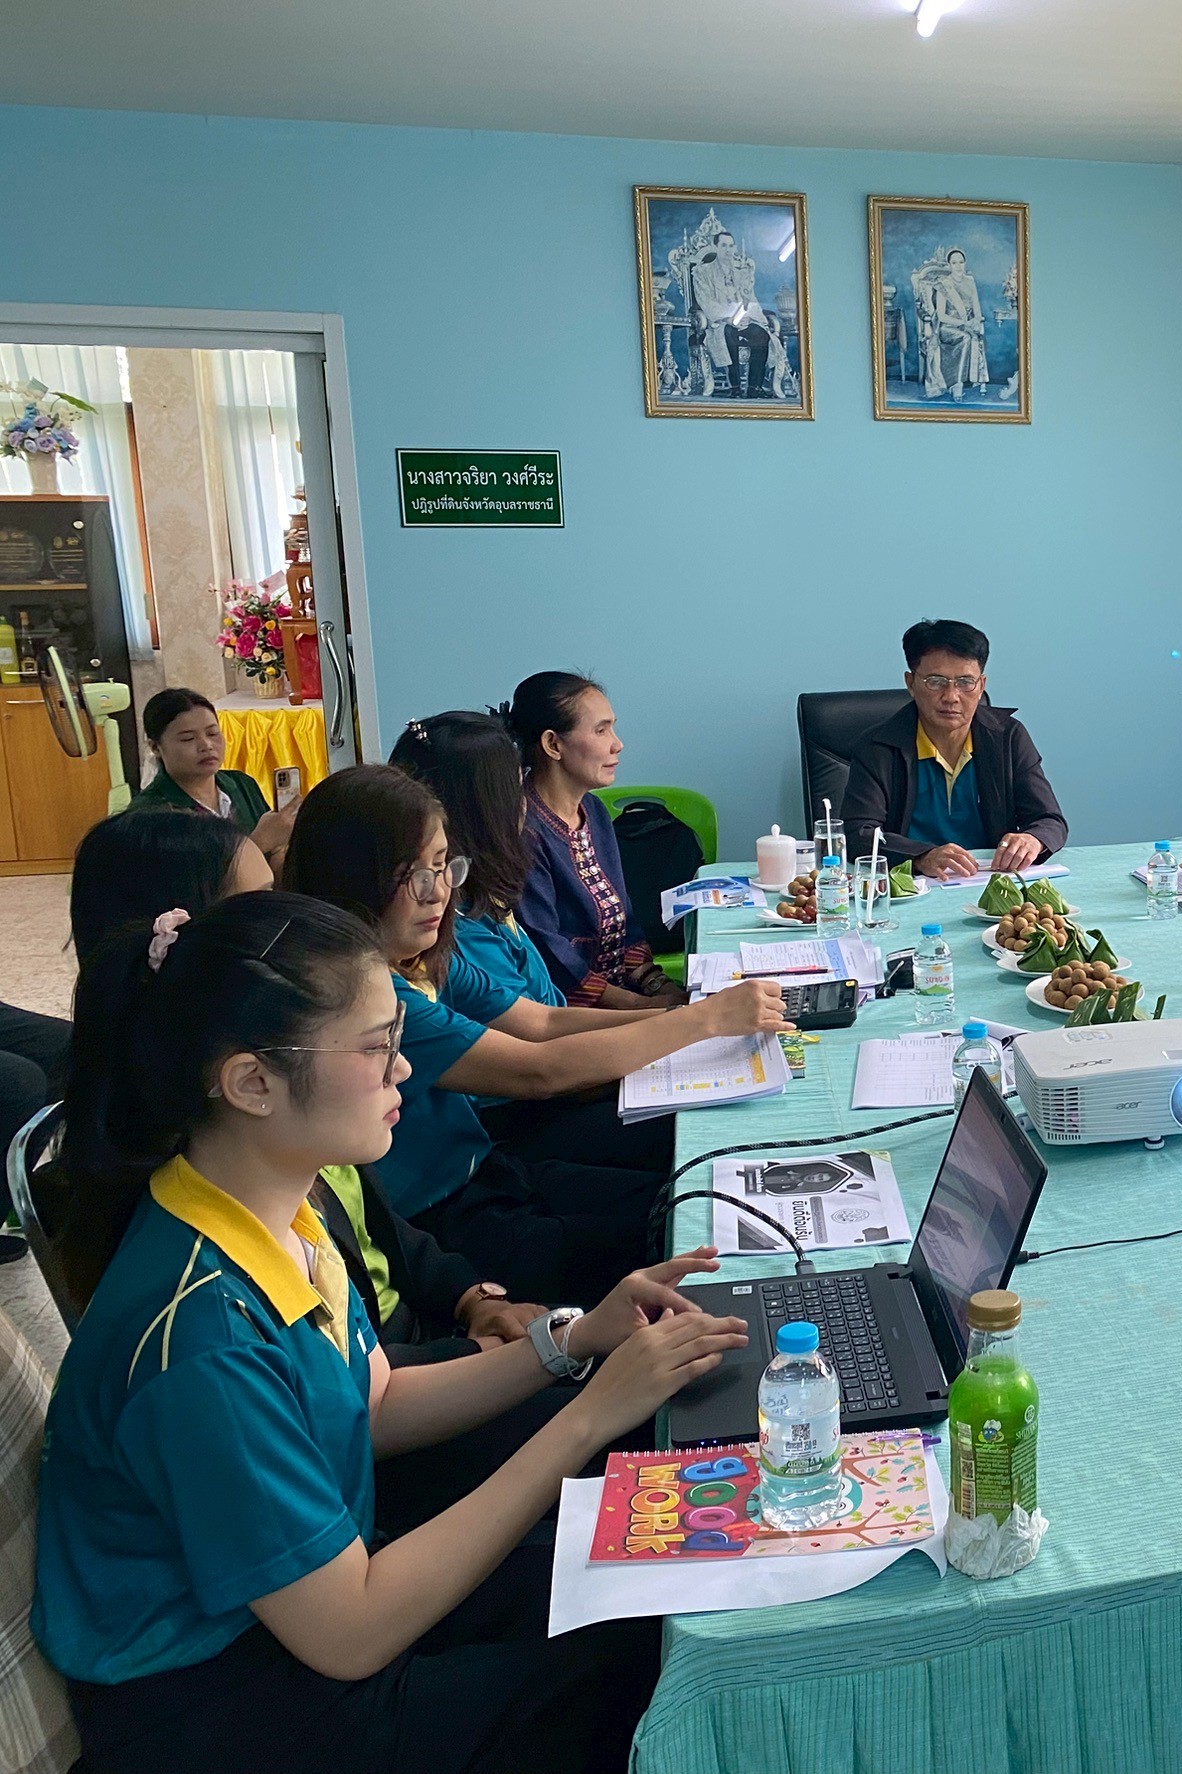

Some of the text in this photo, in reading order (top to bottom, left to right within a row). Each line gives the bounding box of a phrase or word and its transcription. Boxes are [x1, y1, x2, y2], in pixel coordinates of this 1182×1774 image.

[407, 463, 554, 486] นางสาวจริยา วงศ์วีระ
[1114, 1101, 1142, 1111] acer
